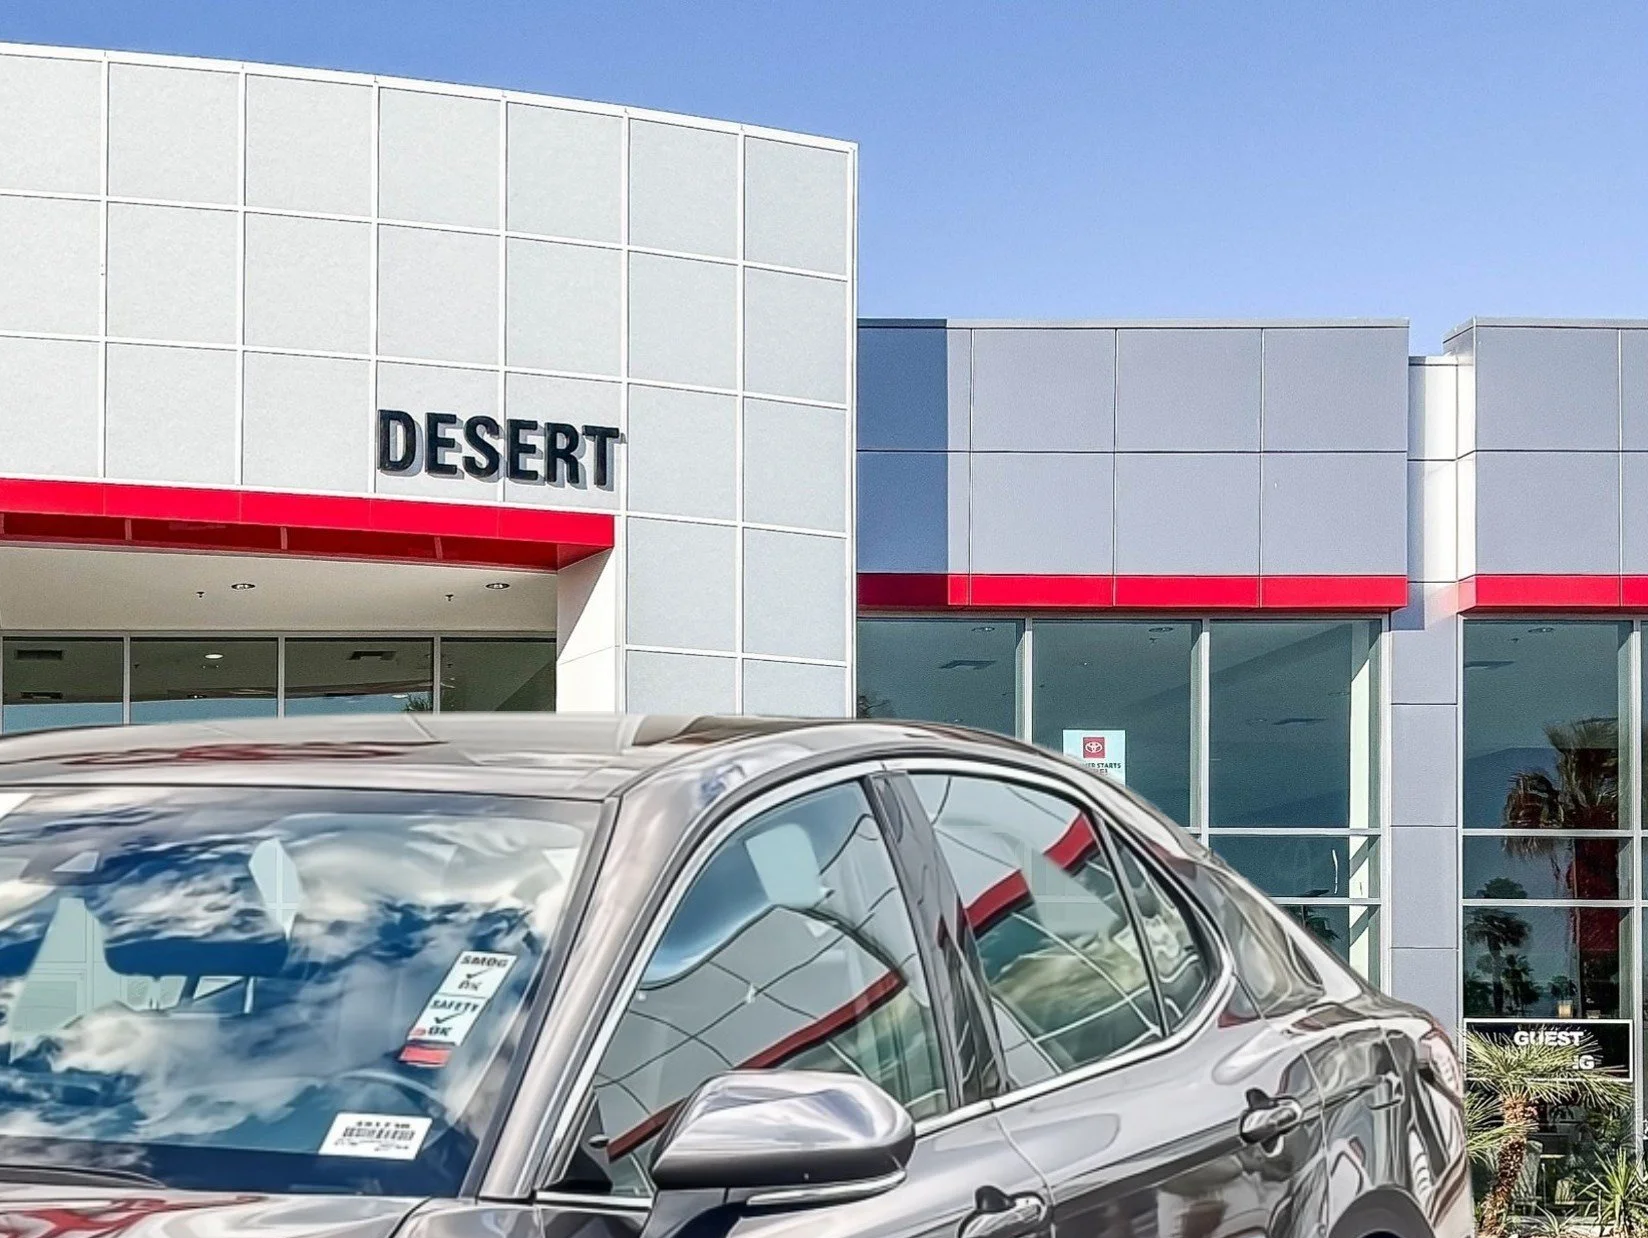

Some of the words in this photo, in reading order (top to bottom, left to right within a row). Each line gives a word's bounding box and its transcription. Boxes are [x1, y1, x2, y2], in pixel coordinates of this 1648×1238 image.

[377, 409, 620, 486] DESERT
[460, 955, 508, 967] SMOG
[431, 1000, 479, 1012] SAFETY
[427, 1027, 453, 1036] OK
[1513, 1030, 1584, 1047] GUEST
